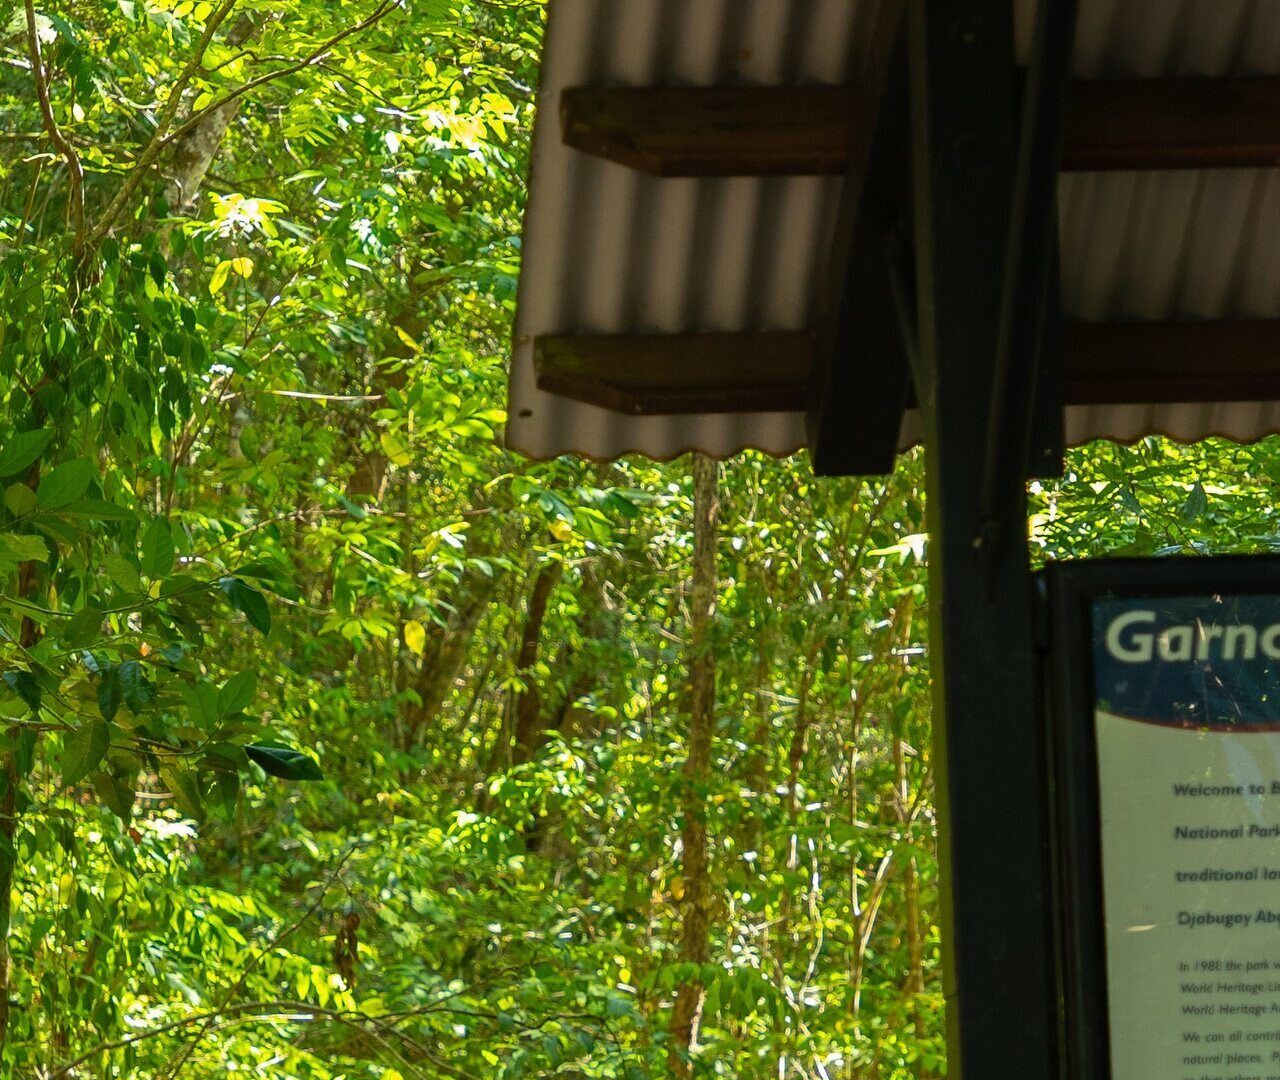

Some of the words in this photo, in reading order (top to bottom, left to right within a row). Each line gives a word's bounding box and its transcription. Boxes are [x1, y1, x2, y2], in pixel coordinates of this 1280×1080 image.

[1173, 783, 1244, 796] Welcome
[1249, 783, 1265, 795] to
[1174, 825, 1244, 839] National
[1175, 868, 1259, 881] traditional
[1178, 910, 1252, 928] Djabugay
[1179, 960, 1190, 971] In
[1225, 959, 1243, 970] the
[1246, 959, 1271, 973] park
[1179, 982, 1213, 993] World
[1217, 981, 1265, 995] Heritage
[1181, 1004, 1215, 1015] World
[1219, 1003, 1268, 1018] Heritage
[1182, 1031, 1201, 1042] We
[1205, 1034, 1225, 1042] can
[1229, 1030, 1243, 1041] all
[1183, 1053, 1223, 1064] natural
[1226, 1052, 1265, 1067] places.
